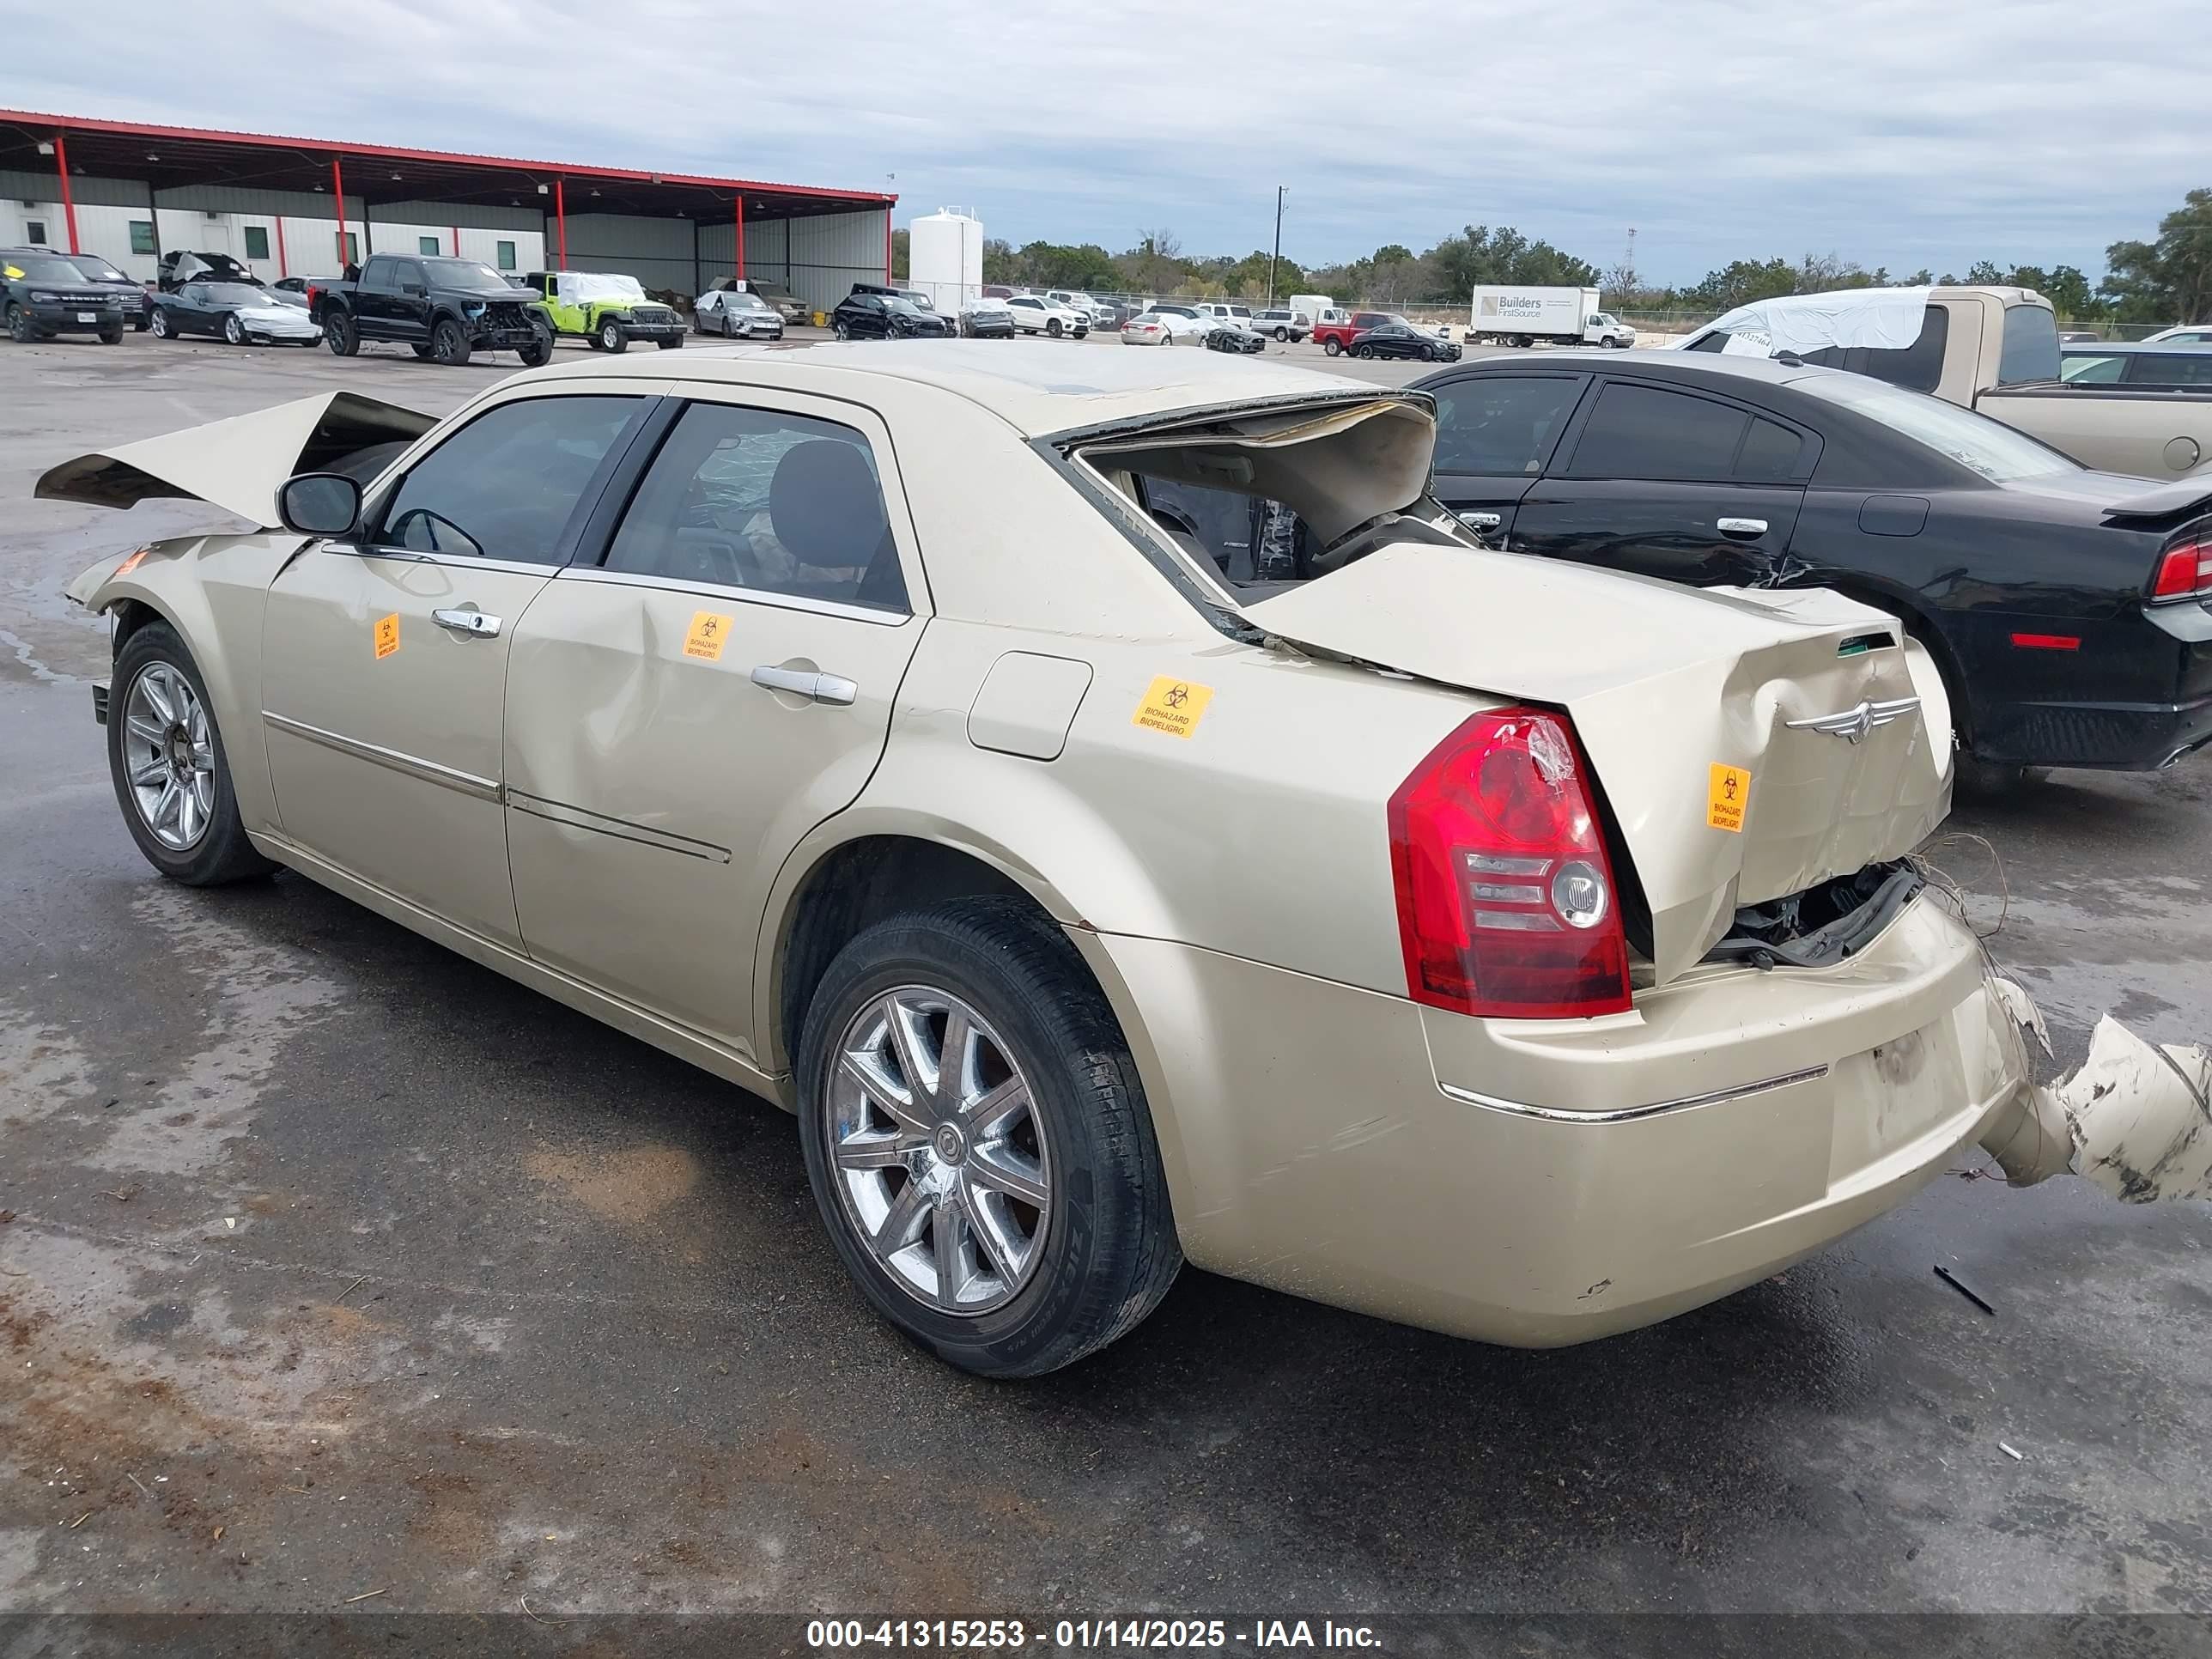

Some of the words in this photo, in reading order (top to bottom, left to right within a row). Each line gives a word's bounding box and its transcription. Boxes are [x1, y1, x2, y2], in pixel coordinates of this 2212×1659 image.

[1499, 296, 1541, 308] Builders
[1498, 308, 1541, 317] FirstSource
[1145, 707, 1189, 725] BIOHAZARD
[1139, 717, 1185, 735] BIOPELIGRO
[1714, 803, 1741, 817] BIOHAZARD
[1712, 816, 1740, 829] BIOPELIGRO
